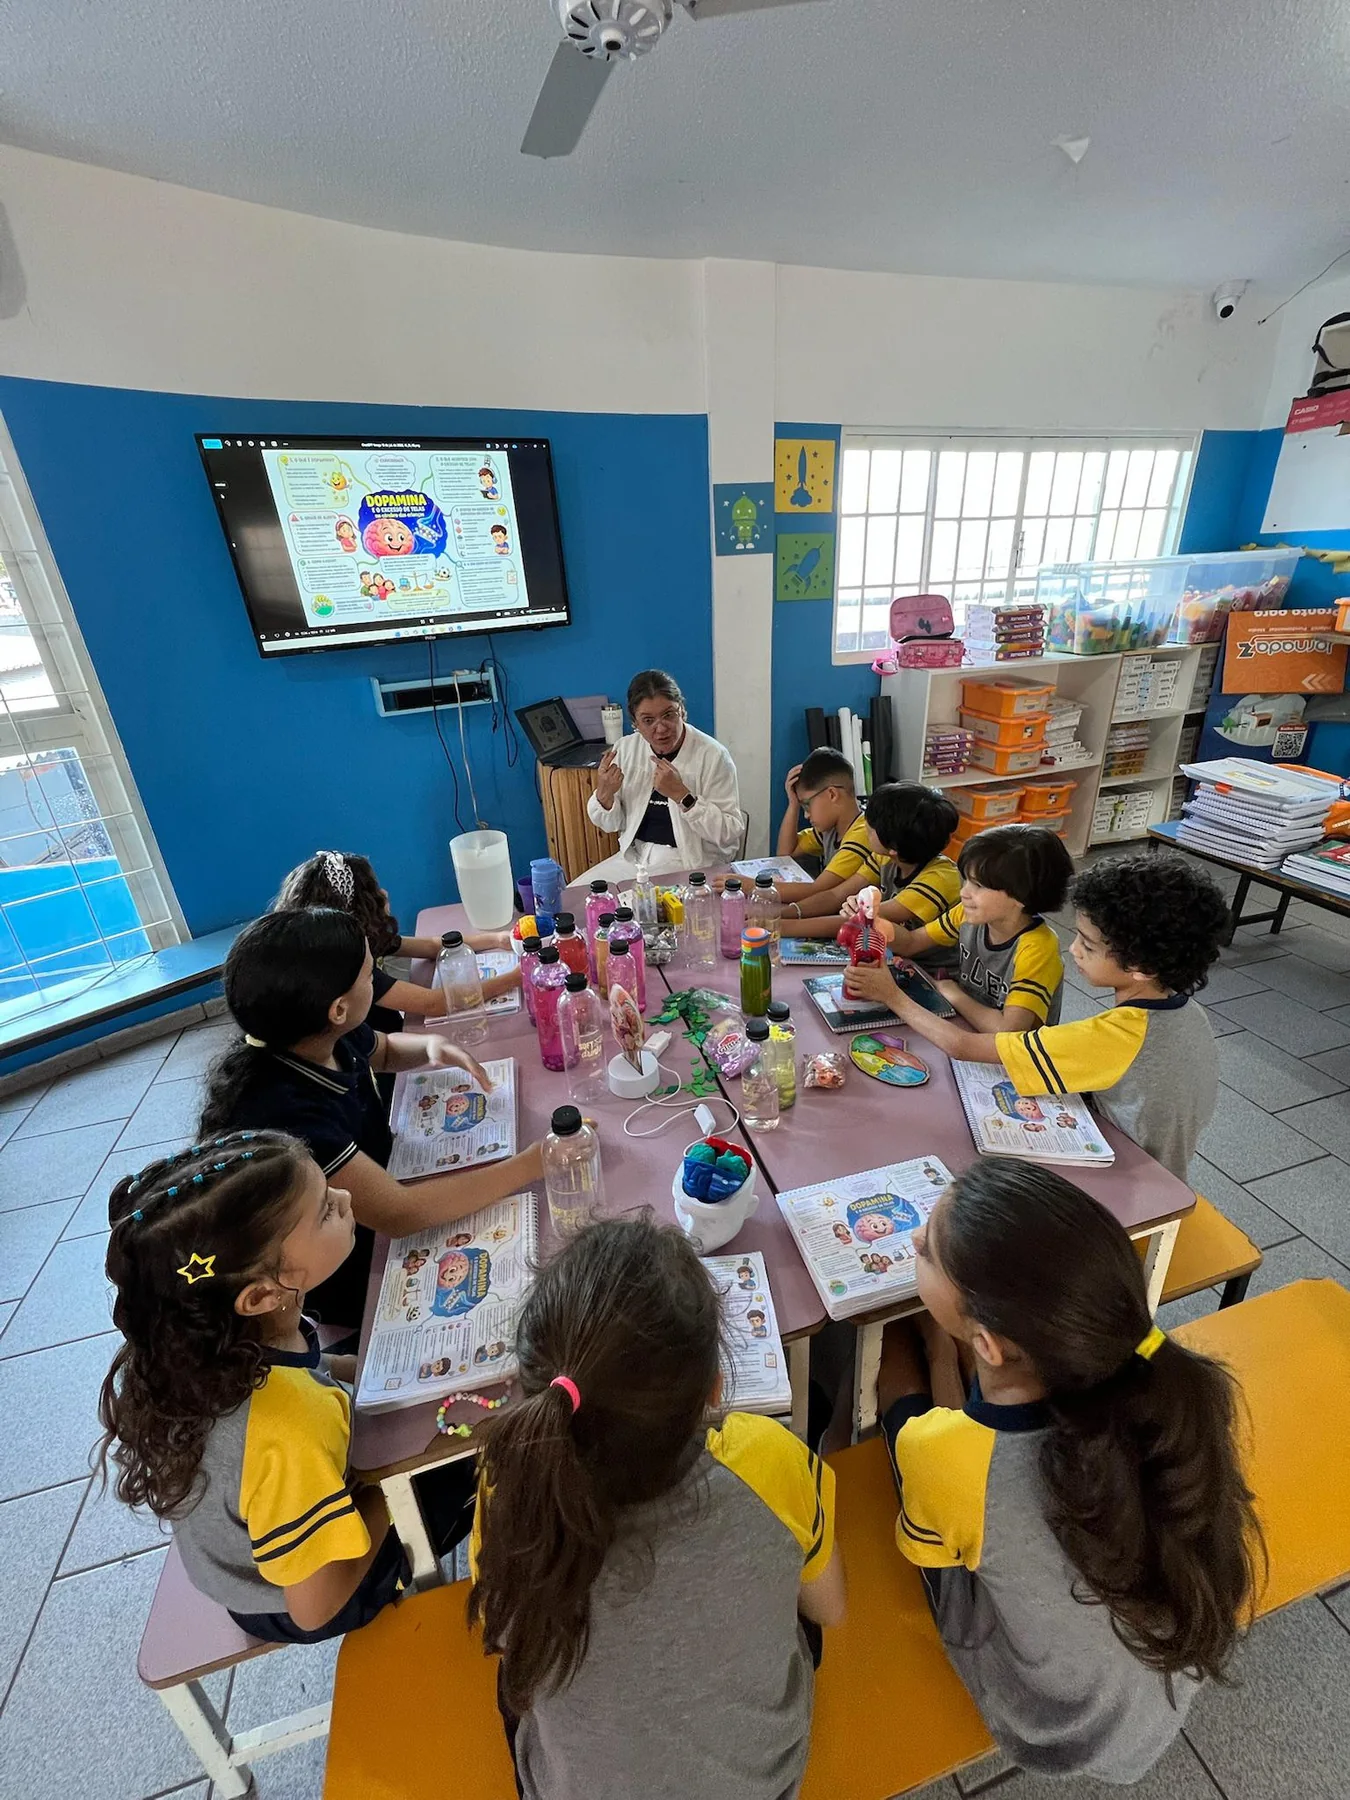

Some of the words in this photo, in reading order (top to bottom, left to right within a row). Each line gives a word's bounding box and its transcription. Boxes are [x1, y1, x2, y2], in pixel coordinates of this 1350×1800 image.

[366, 494, 427, 507] DOPAMINA
[850, 1194, 894, 1211] DOPAMINA
[477, 1252, 488, 1298] DOPAMINA
